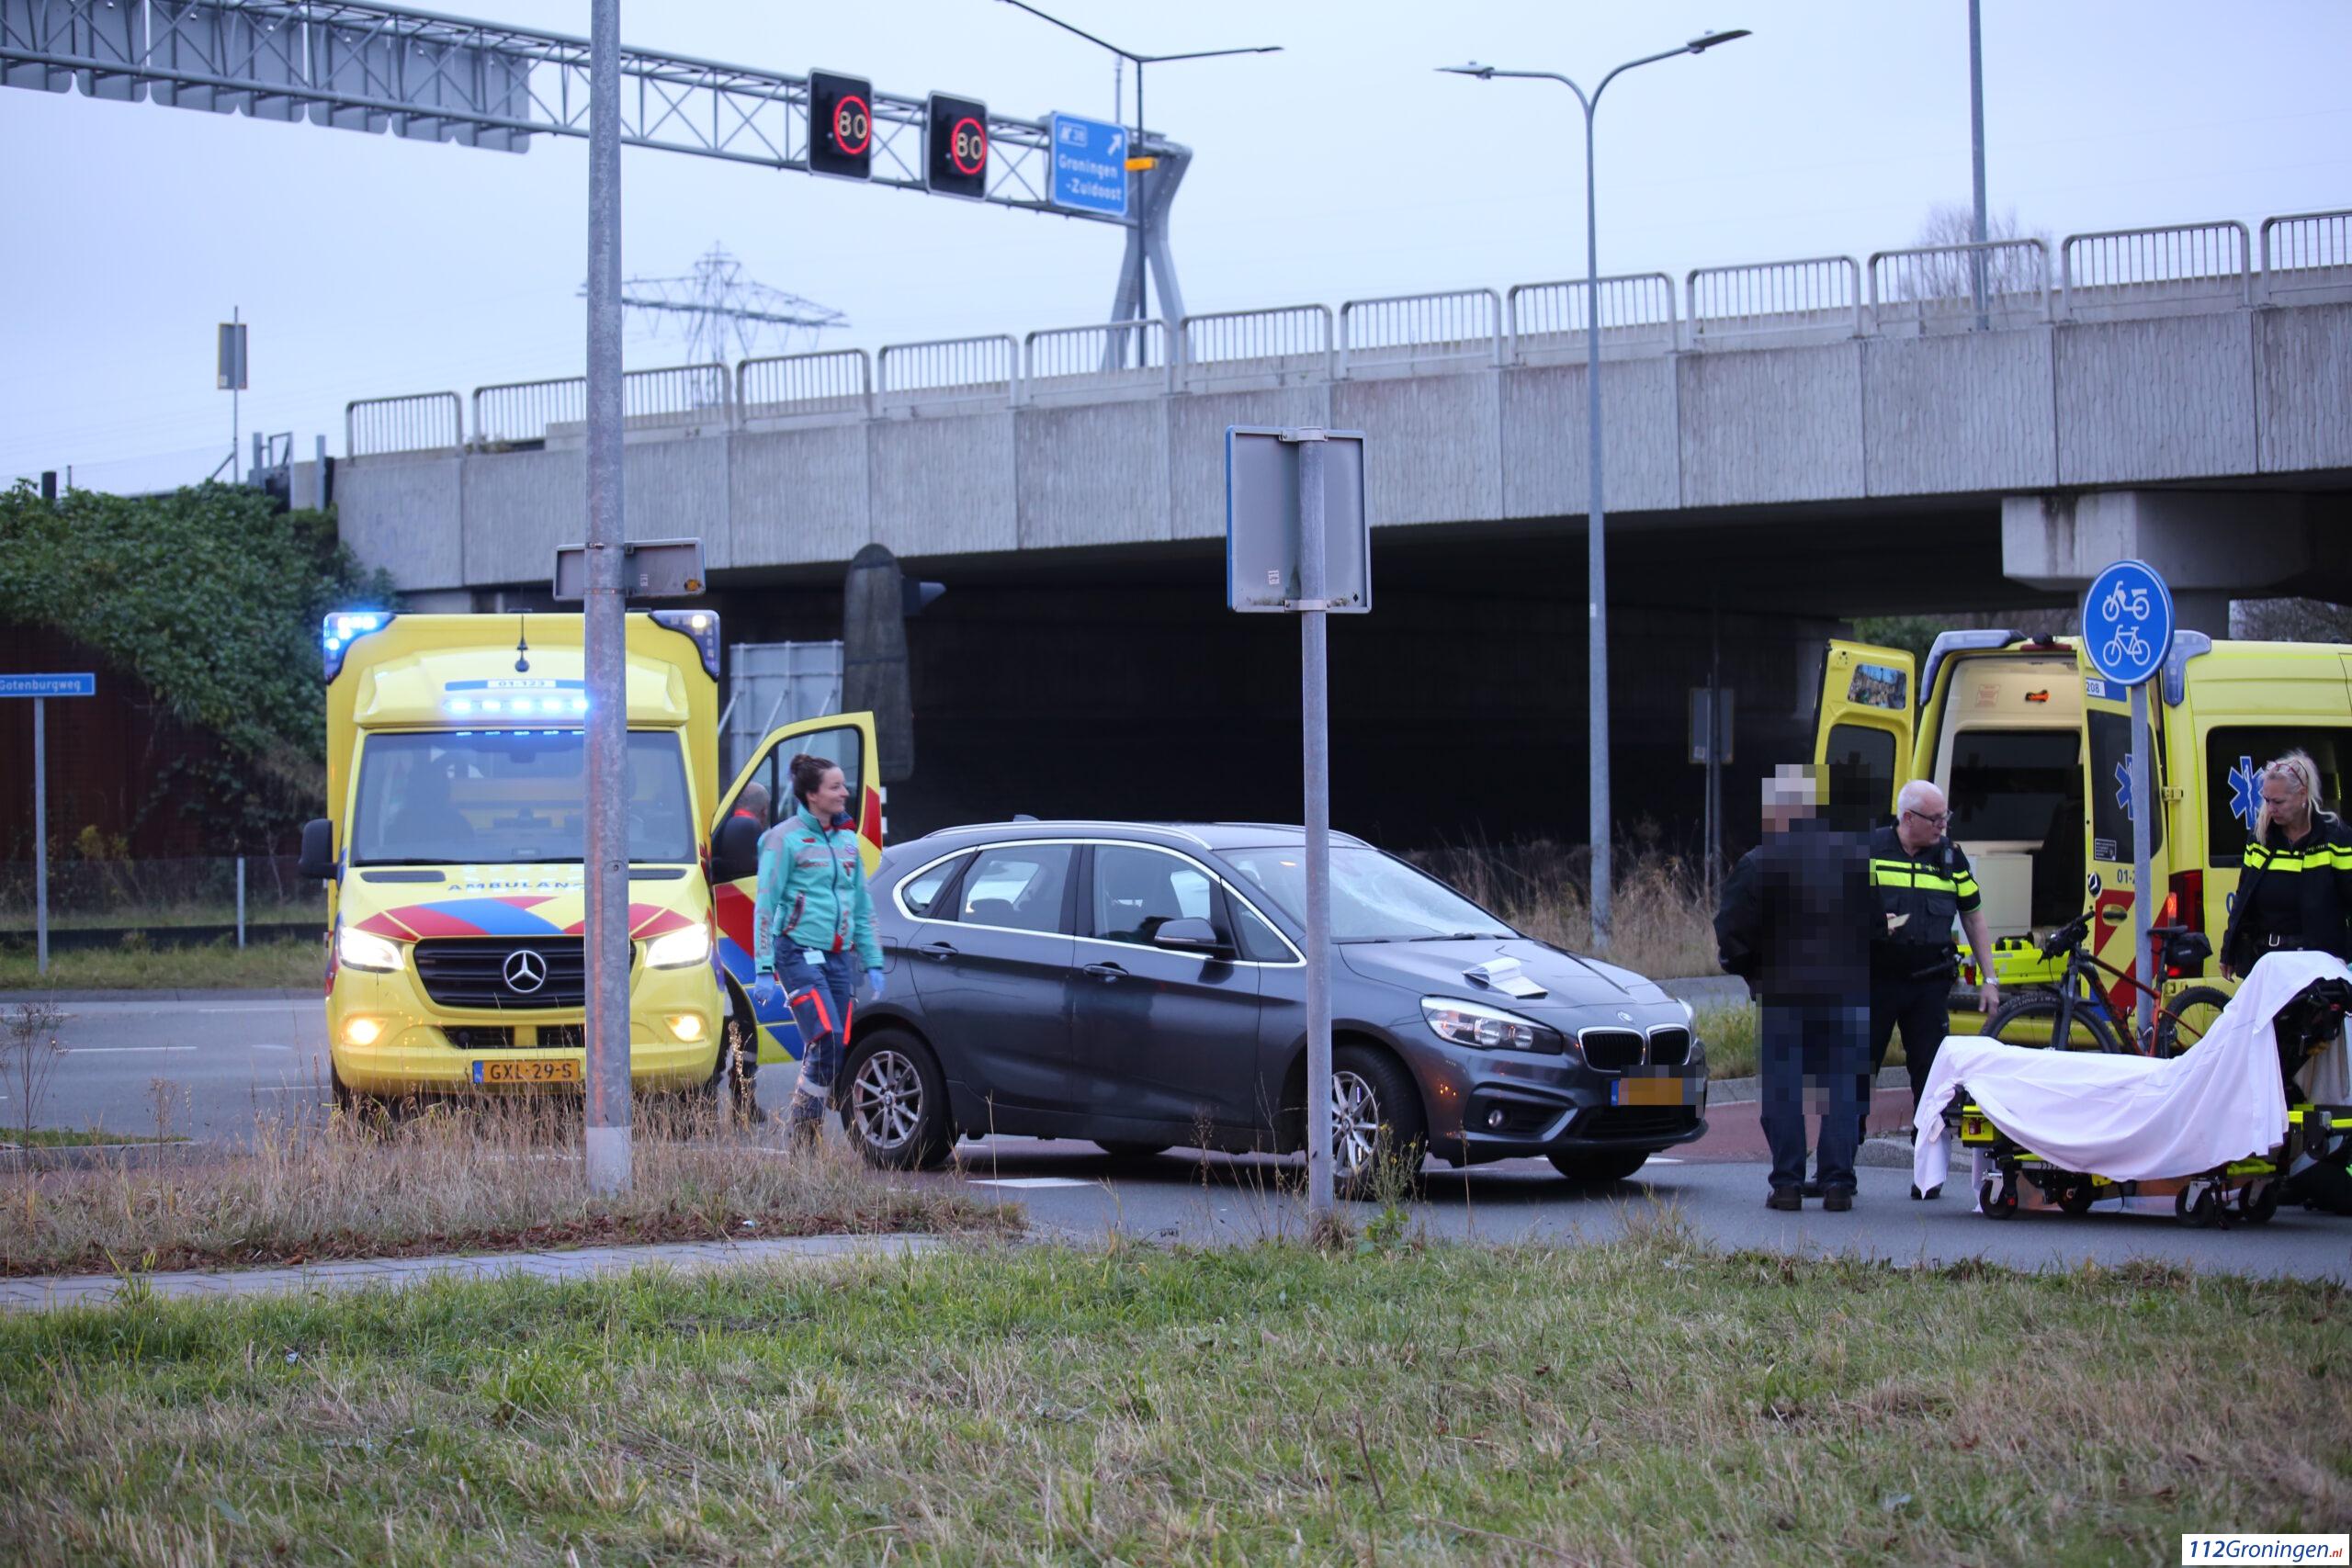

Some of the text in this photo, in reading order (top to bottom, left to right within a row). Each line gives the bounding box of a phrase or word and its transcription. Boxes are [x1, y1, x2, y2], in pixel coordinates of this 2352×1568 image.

[838, 111, 868, 139] 80
[956, 132, 983, 160] 80
[1058, 152, 1119, 180] Groningen
[0, 680, 81, 693] Gotenburgweg
[490, 1063, 572, 1080] GXL-29-S
